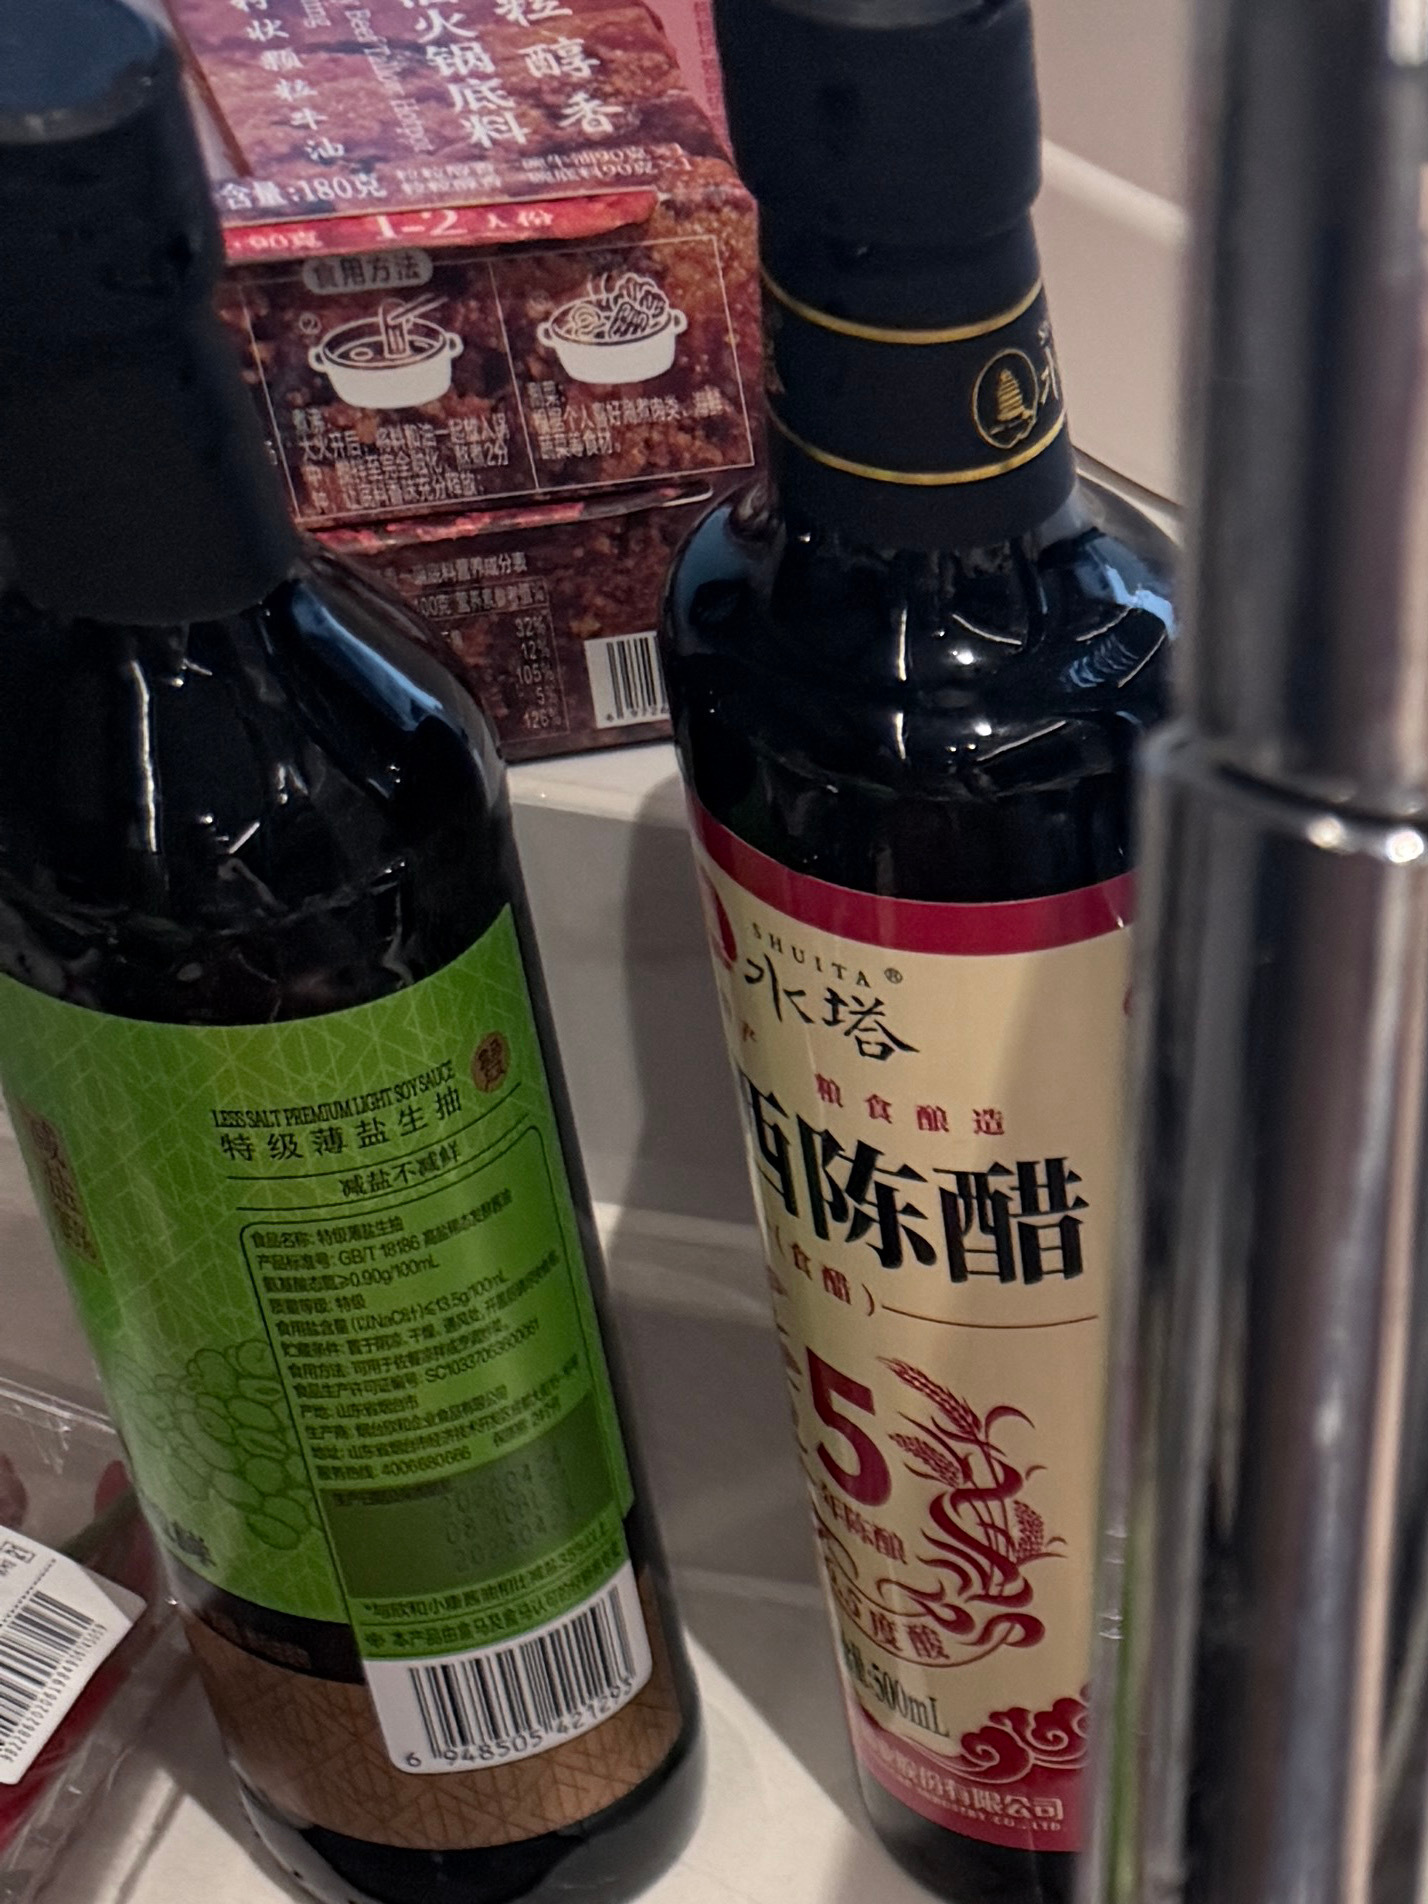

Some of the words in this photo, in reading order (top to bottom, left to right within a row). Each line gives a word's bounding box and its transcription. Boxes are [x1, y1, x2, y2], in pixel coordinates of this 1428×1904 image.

[404, 0, 531, 149] 火锅底料
[313, 256, 421, 288] 食用方法
[752, 922, 872, 989] SHUITA
[744, 953, 921, 1062] 水塔
[219, 1086, 463, 1162] 特级薄盐生抽
[248, 1110, 283, 1129] SALT
[282, 1100, 351, 1128] PREMIUM
[814, 1072, 1006, 1137] 粮食酿造
[339, 1140, 462, 1198] 减盐不减鲜
[805, 1345, 893, 1508] 5
[403, 1750, 423, 1768] 6
[442, 1728, 544, 1766] 948505
